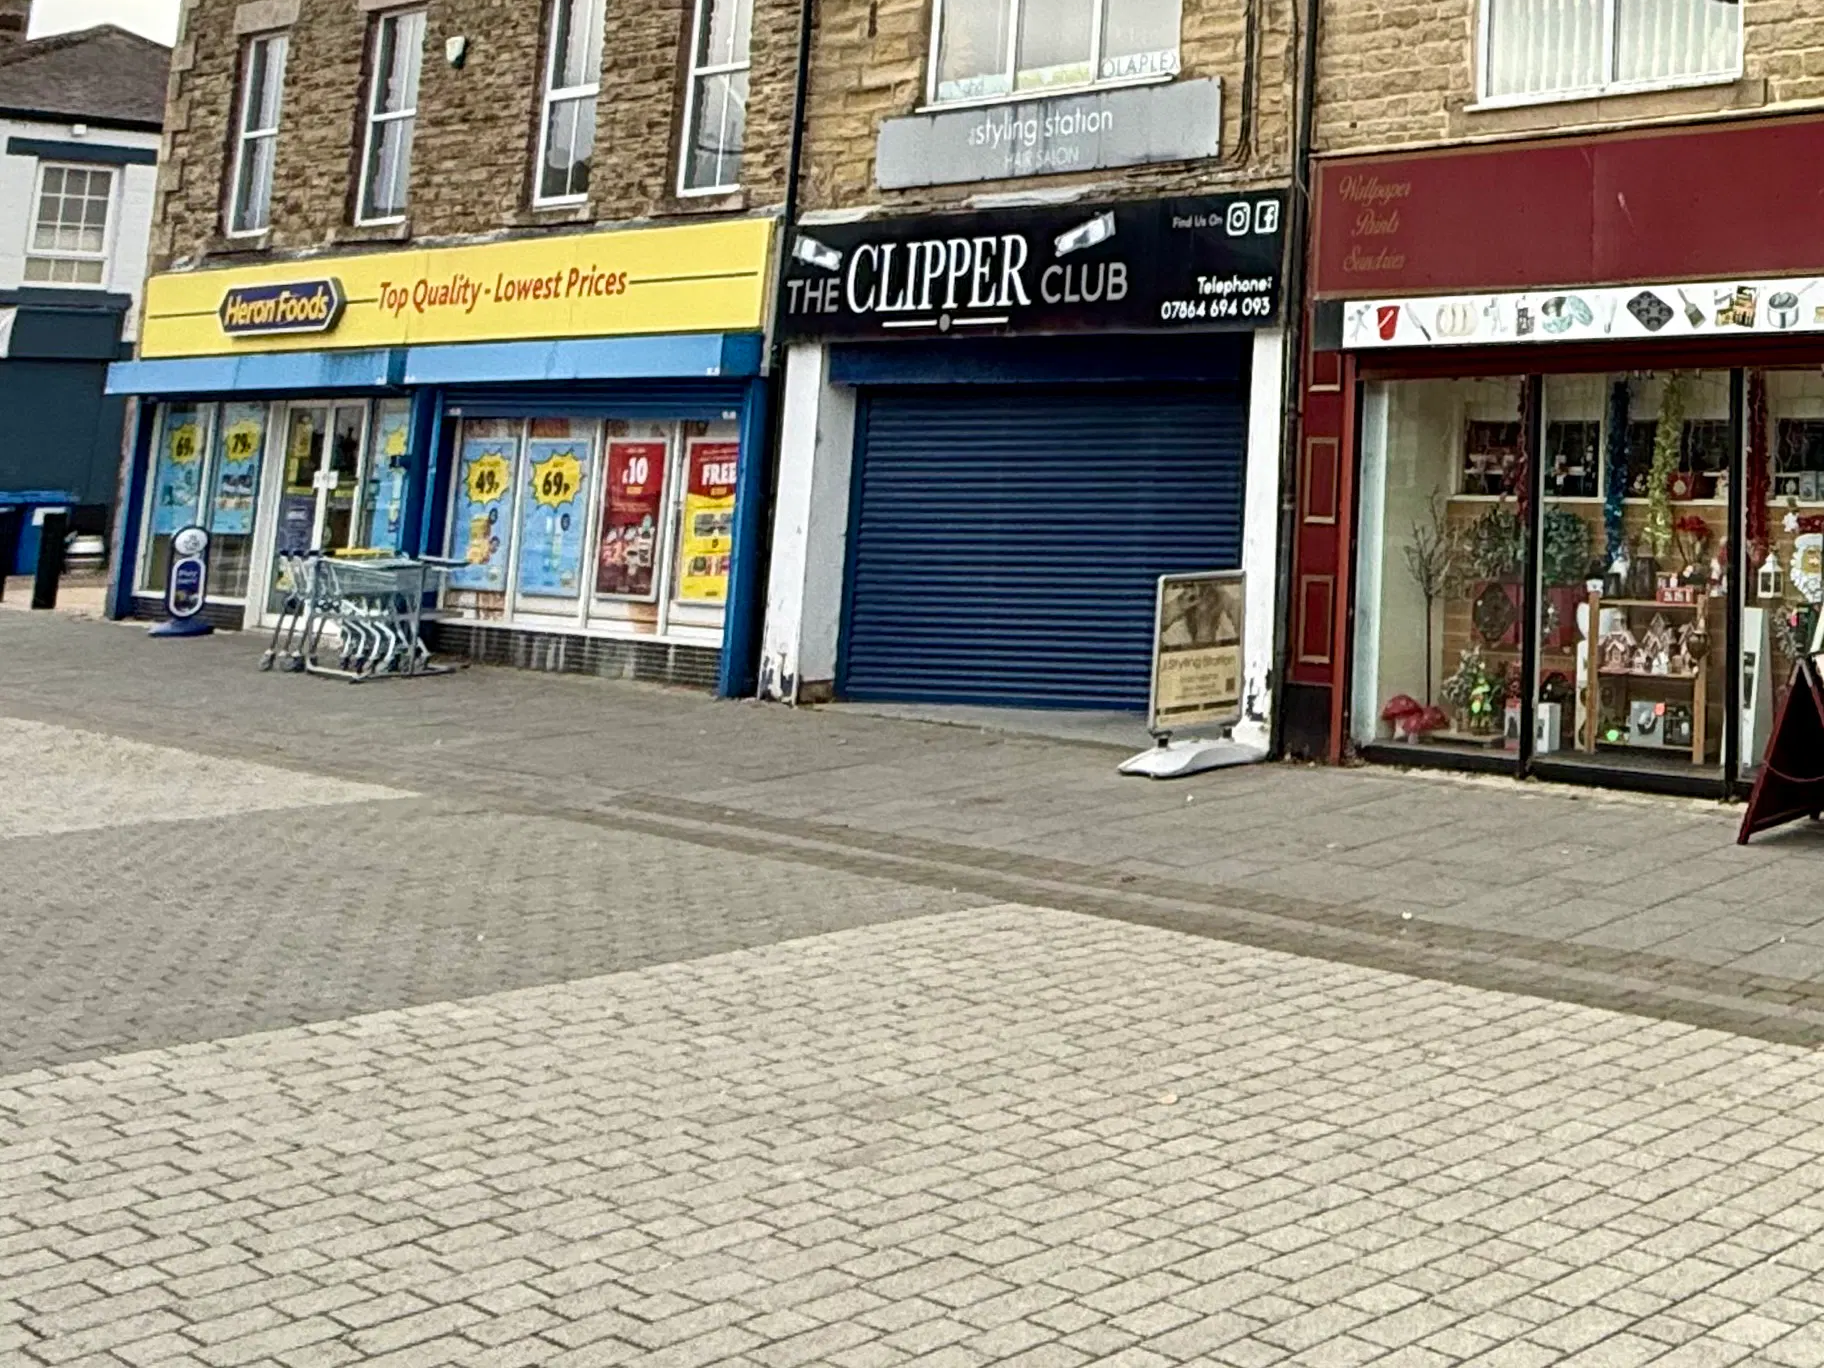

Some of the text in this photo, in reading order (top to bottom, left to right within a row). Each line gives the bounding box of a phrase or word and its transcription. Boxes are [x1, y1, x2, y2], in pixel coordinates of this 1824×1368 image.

[1044, 107, 1113, 137] station
[1037, 147, 1079, 167] SALON
[1172, 213, 1223, 228] Find Us On
[787, 233, 1128, 314] THE CLIPPER CLUB
[379, 281, 409, 318] Top
[412, 273, 482, 314] Quality
[494, 272, 564, 303] Lowest
[565, 263, 627, 298] Prices
[1197, 274, 1273, 298] Telephone:
[225, 285, 329, 326] Heron Foods
[1161, 296, 1271, 320] 07864 694 093
[542, 471, 571, 496] 69p
[702, 462, 737, 486] FREE
